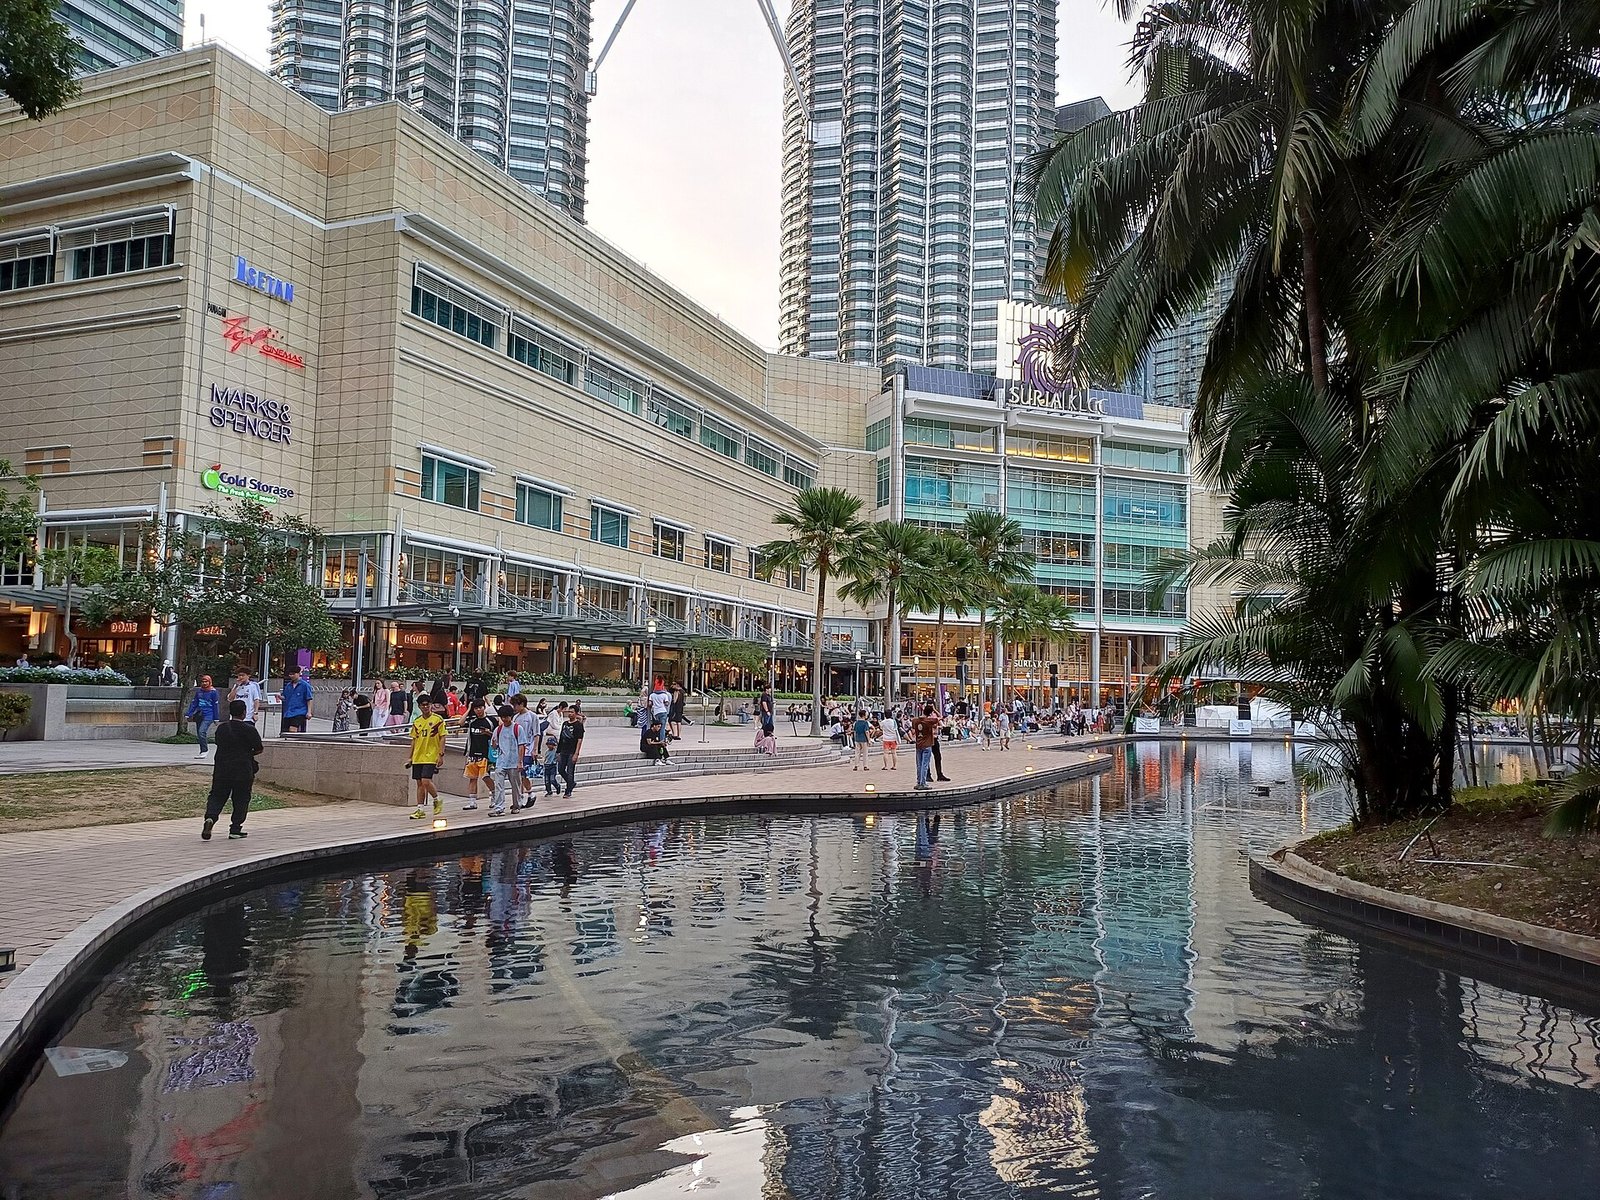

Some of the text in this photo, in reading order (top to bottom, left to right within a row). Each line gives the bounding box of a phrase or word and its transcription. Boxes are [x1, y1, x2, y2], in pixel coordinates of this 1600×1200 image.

[232, 255, 295, 303] ISETAN
[261, 344, 304, 363] CINEMAS
[211, 382, 293, 424] MARKS &
[1008, 386, 1109, 415] SURIA KLCC
[210, 406, 293, 445] SPENCER
[217, 485, 229, 494] The
[219, 472, 295, 499] Cold Storage
[111, 621, 138, 633] DOME
